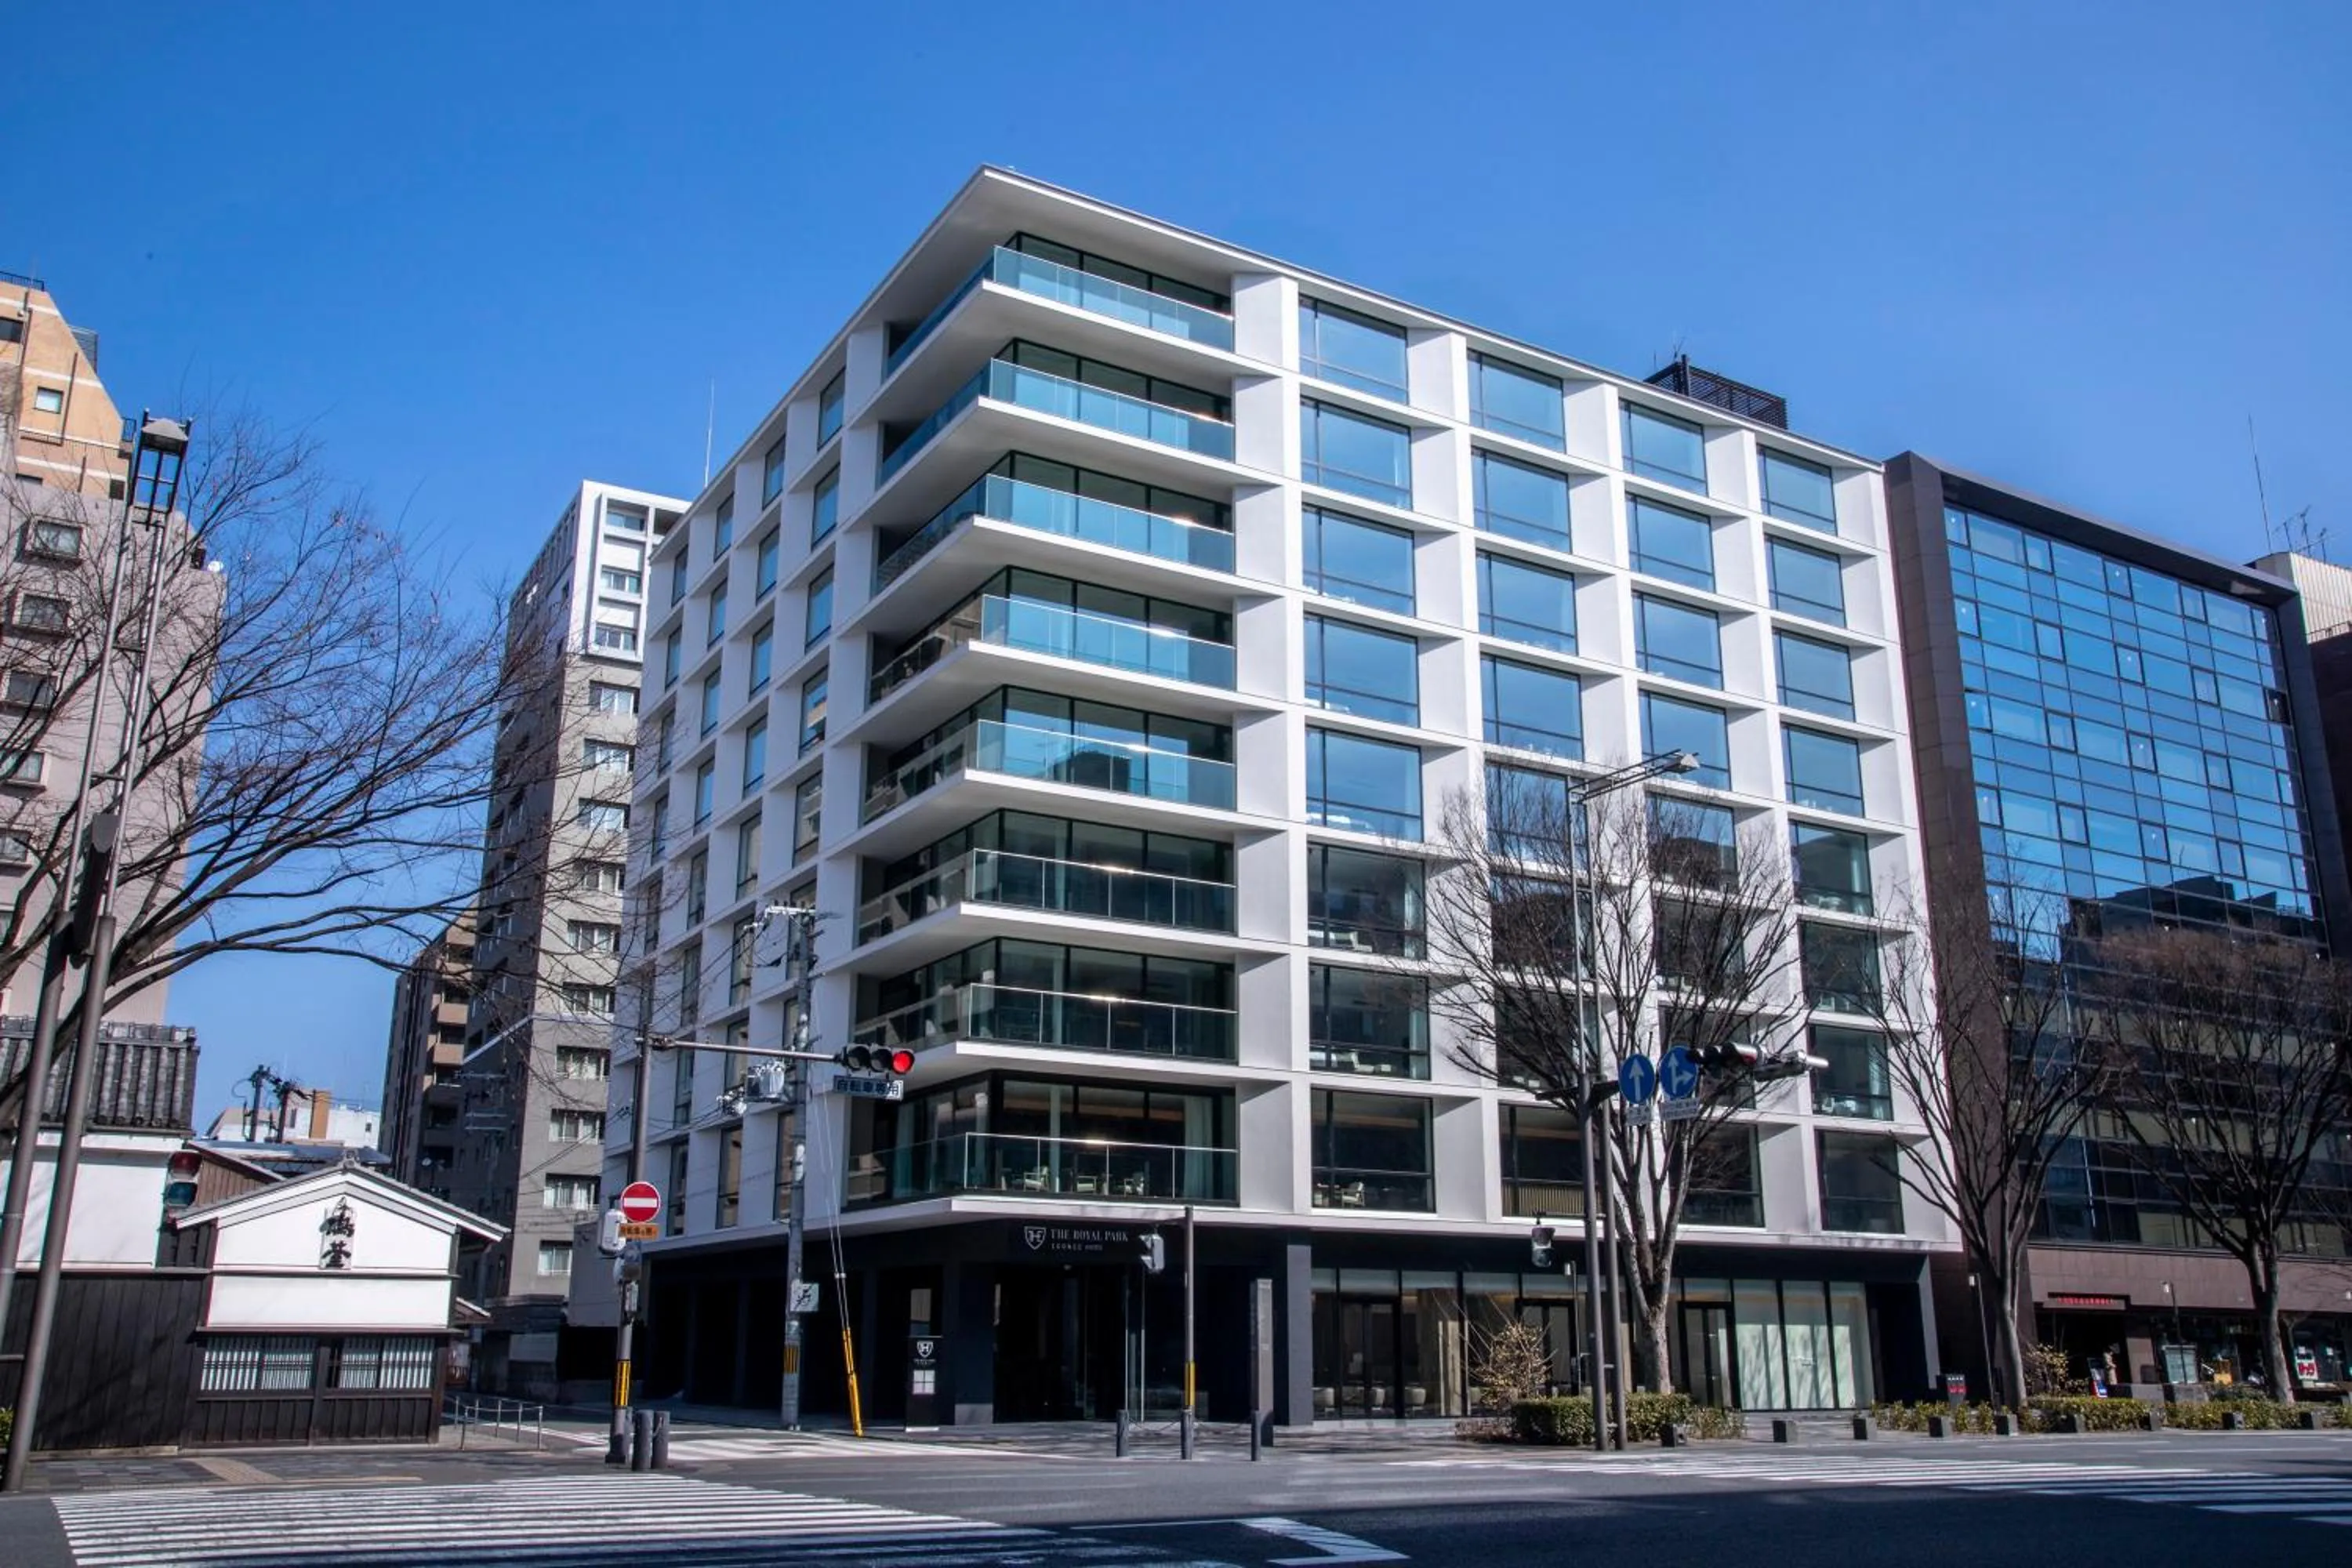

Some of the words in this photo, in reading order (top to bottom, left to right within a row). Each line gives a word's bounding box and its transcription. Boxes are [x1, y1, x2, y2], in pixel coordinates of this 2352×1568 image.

[1051, 1229, 1069, 1240] THE
[1073, 1229, 1103, 1241] ROYAL
[1105, 1230, 1128, 1242] PARK
